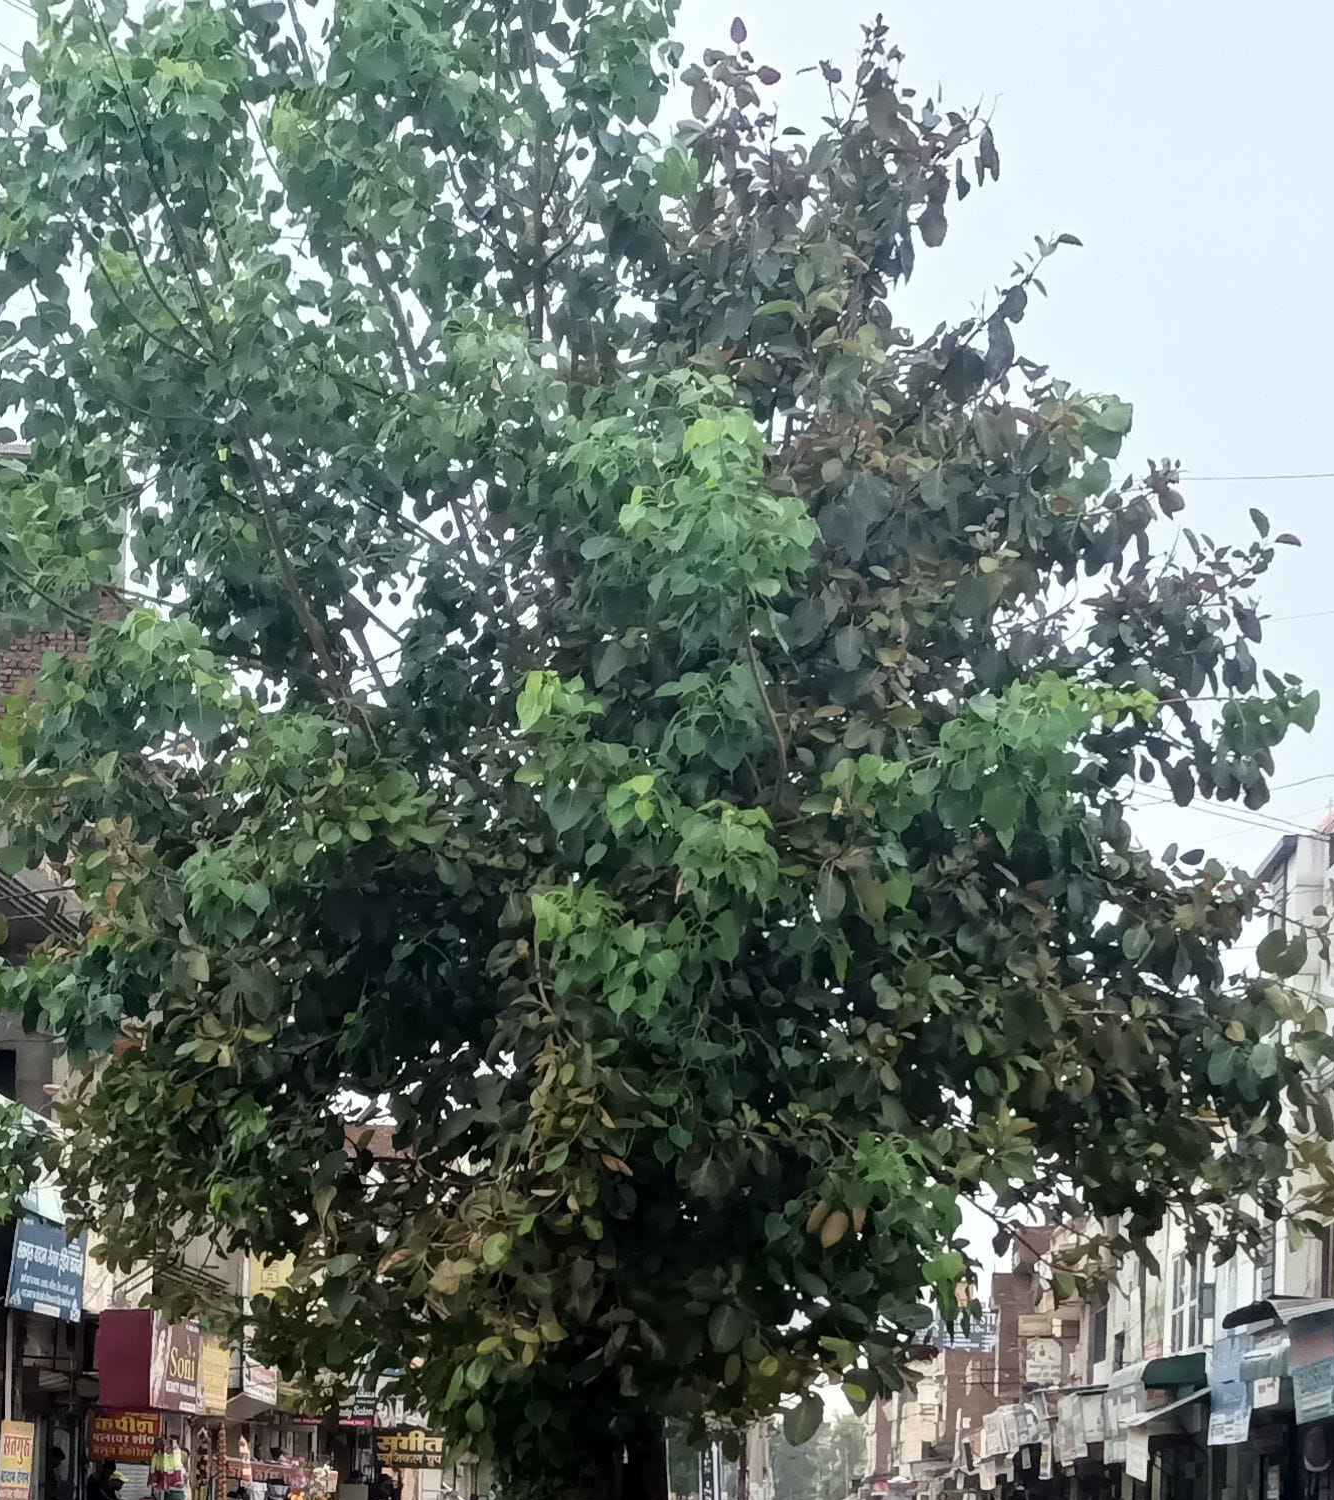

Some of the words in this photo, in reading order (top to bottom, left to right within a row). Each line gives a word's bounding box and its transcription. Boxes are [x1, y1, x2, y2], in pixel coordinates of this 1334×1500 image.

[169, 1346, 196, 1382] Soni
[353, 1403, 375, 1417] Salon
[376, 1430, 444, 1452] संगीत
